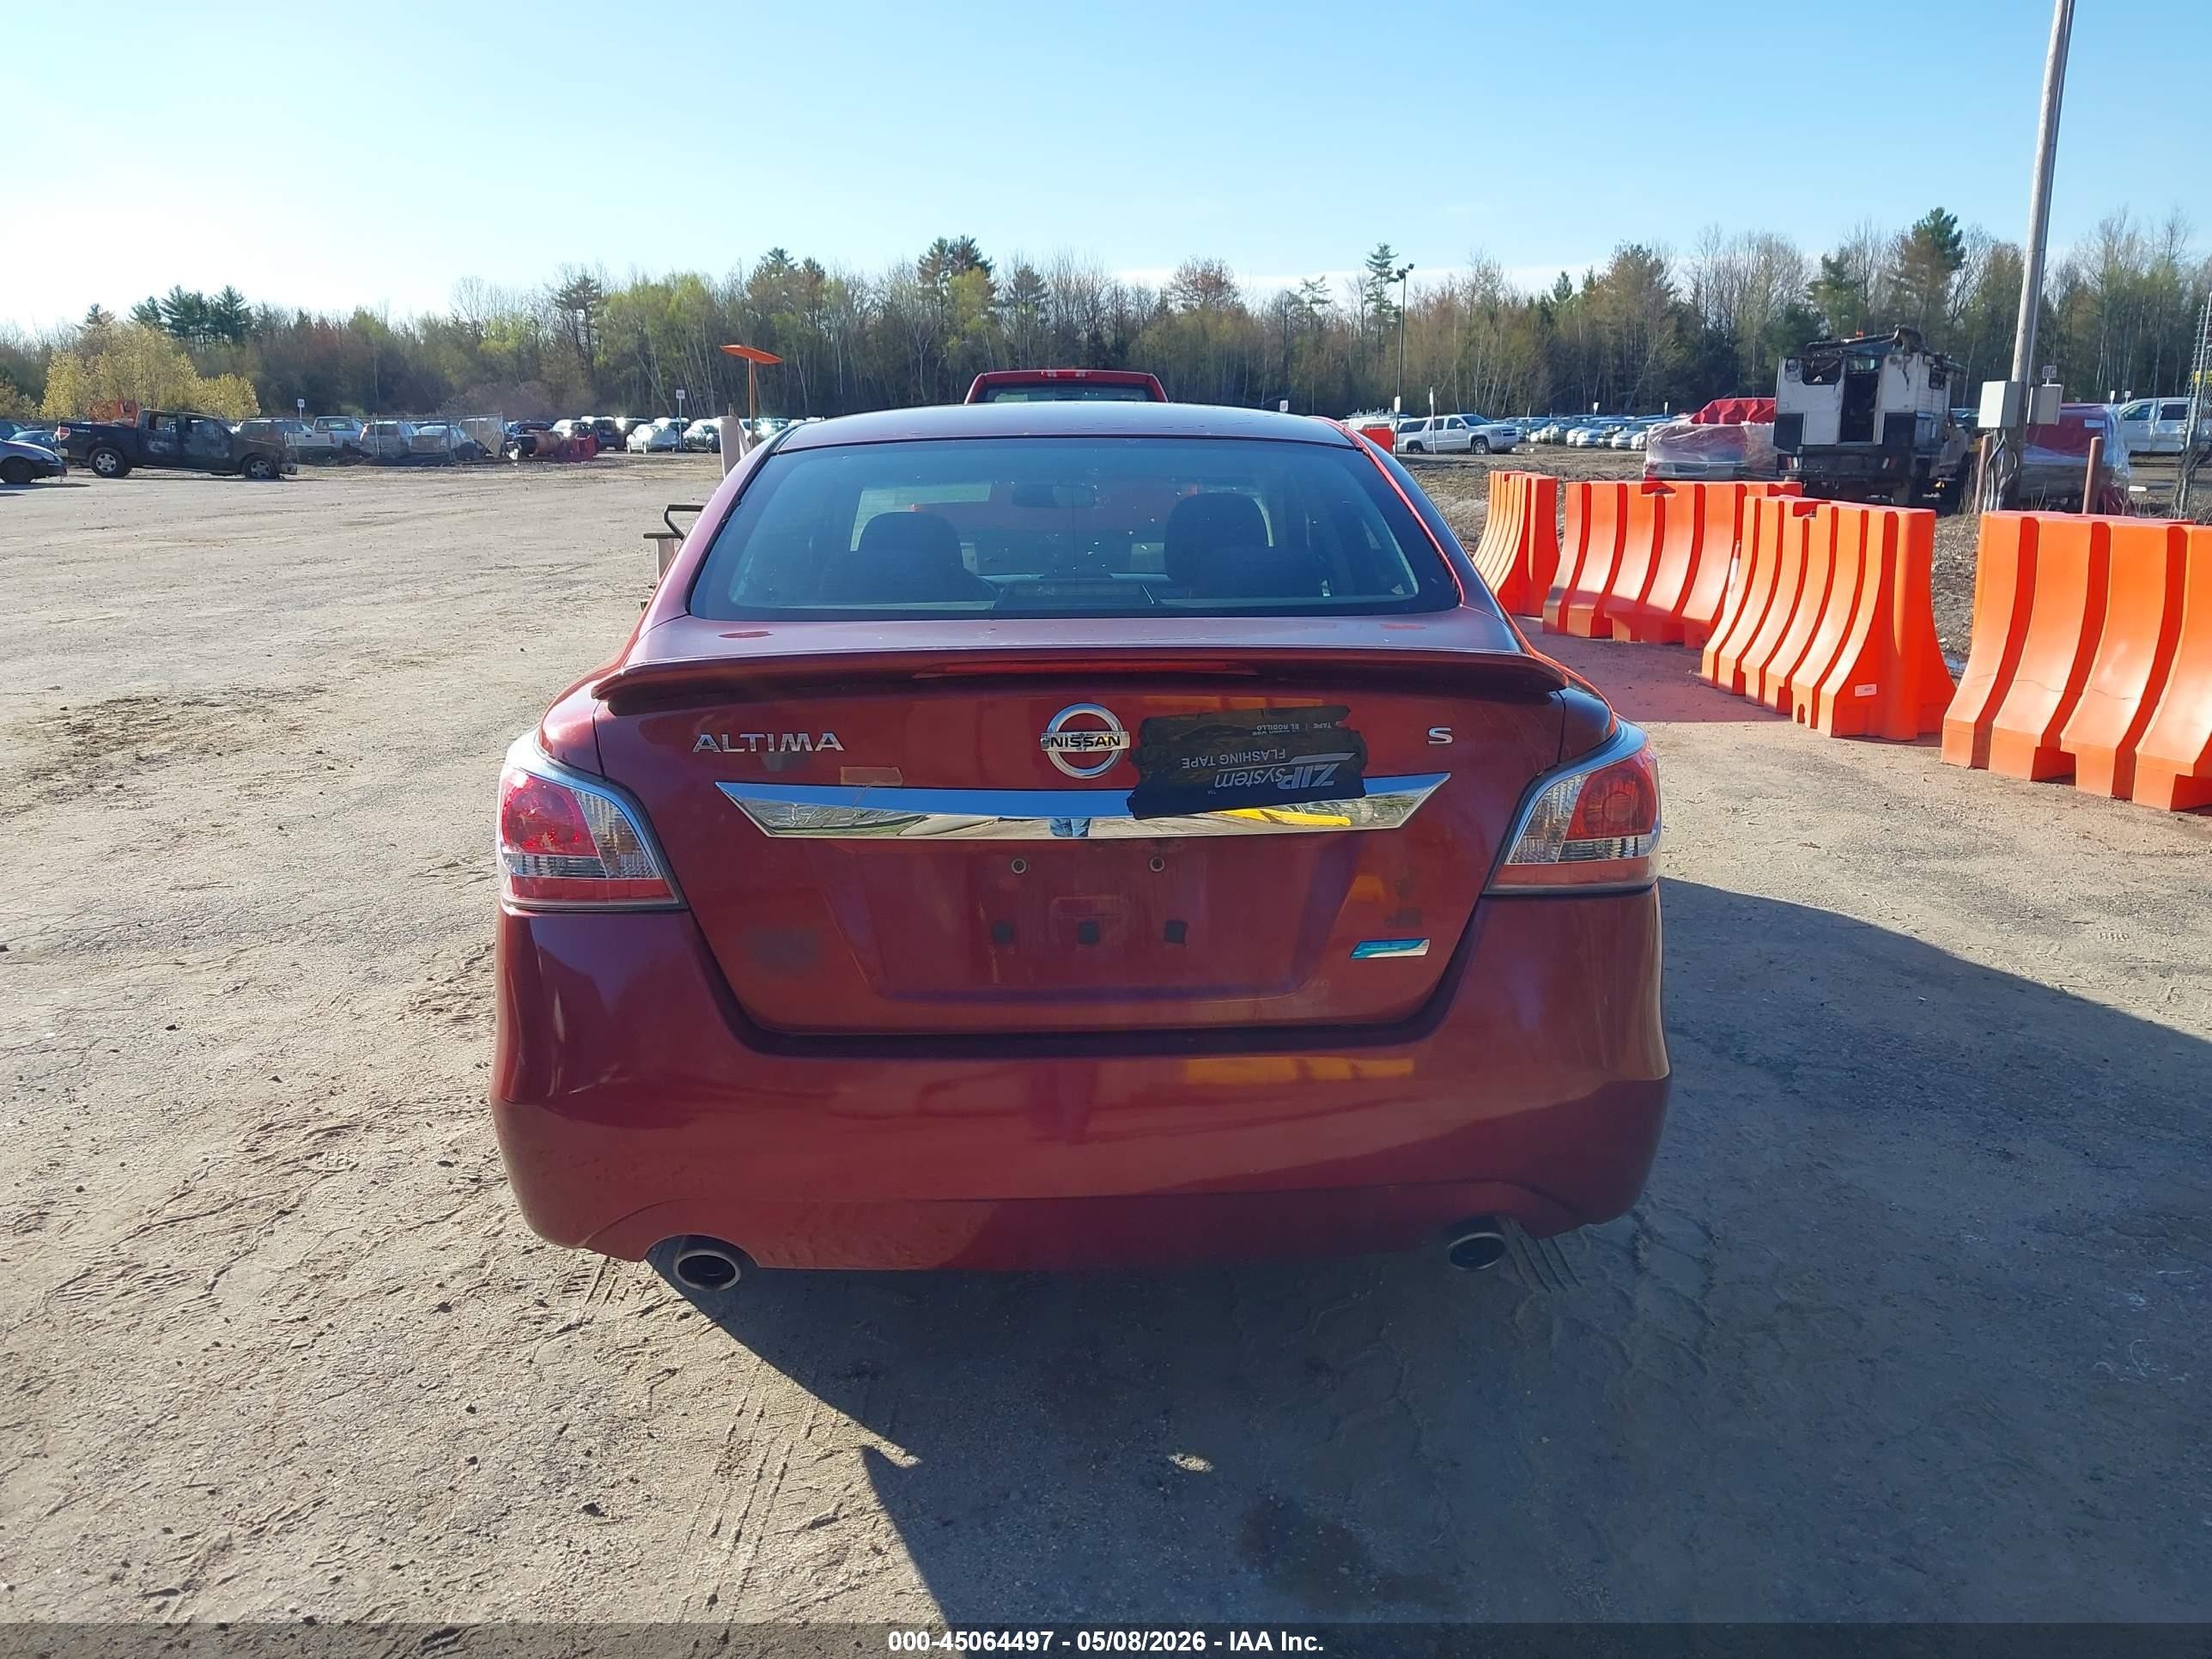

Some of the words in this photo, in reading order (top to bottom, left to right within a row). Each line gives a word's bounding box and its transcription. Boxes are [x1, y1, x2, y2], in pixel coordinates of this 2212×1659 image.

[692, 732, 846, 753] ALTIMA
[1050, 736, 1121, 748] NISSAN
[1427, 726, 1453, 745] S
[1181, 757, 1217, 769] TAPE
[1218, 748, 1285, 765] FLASHING
